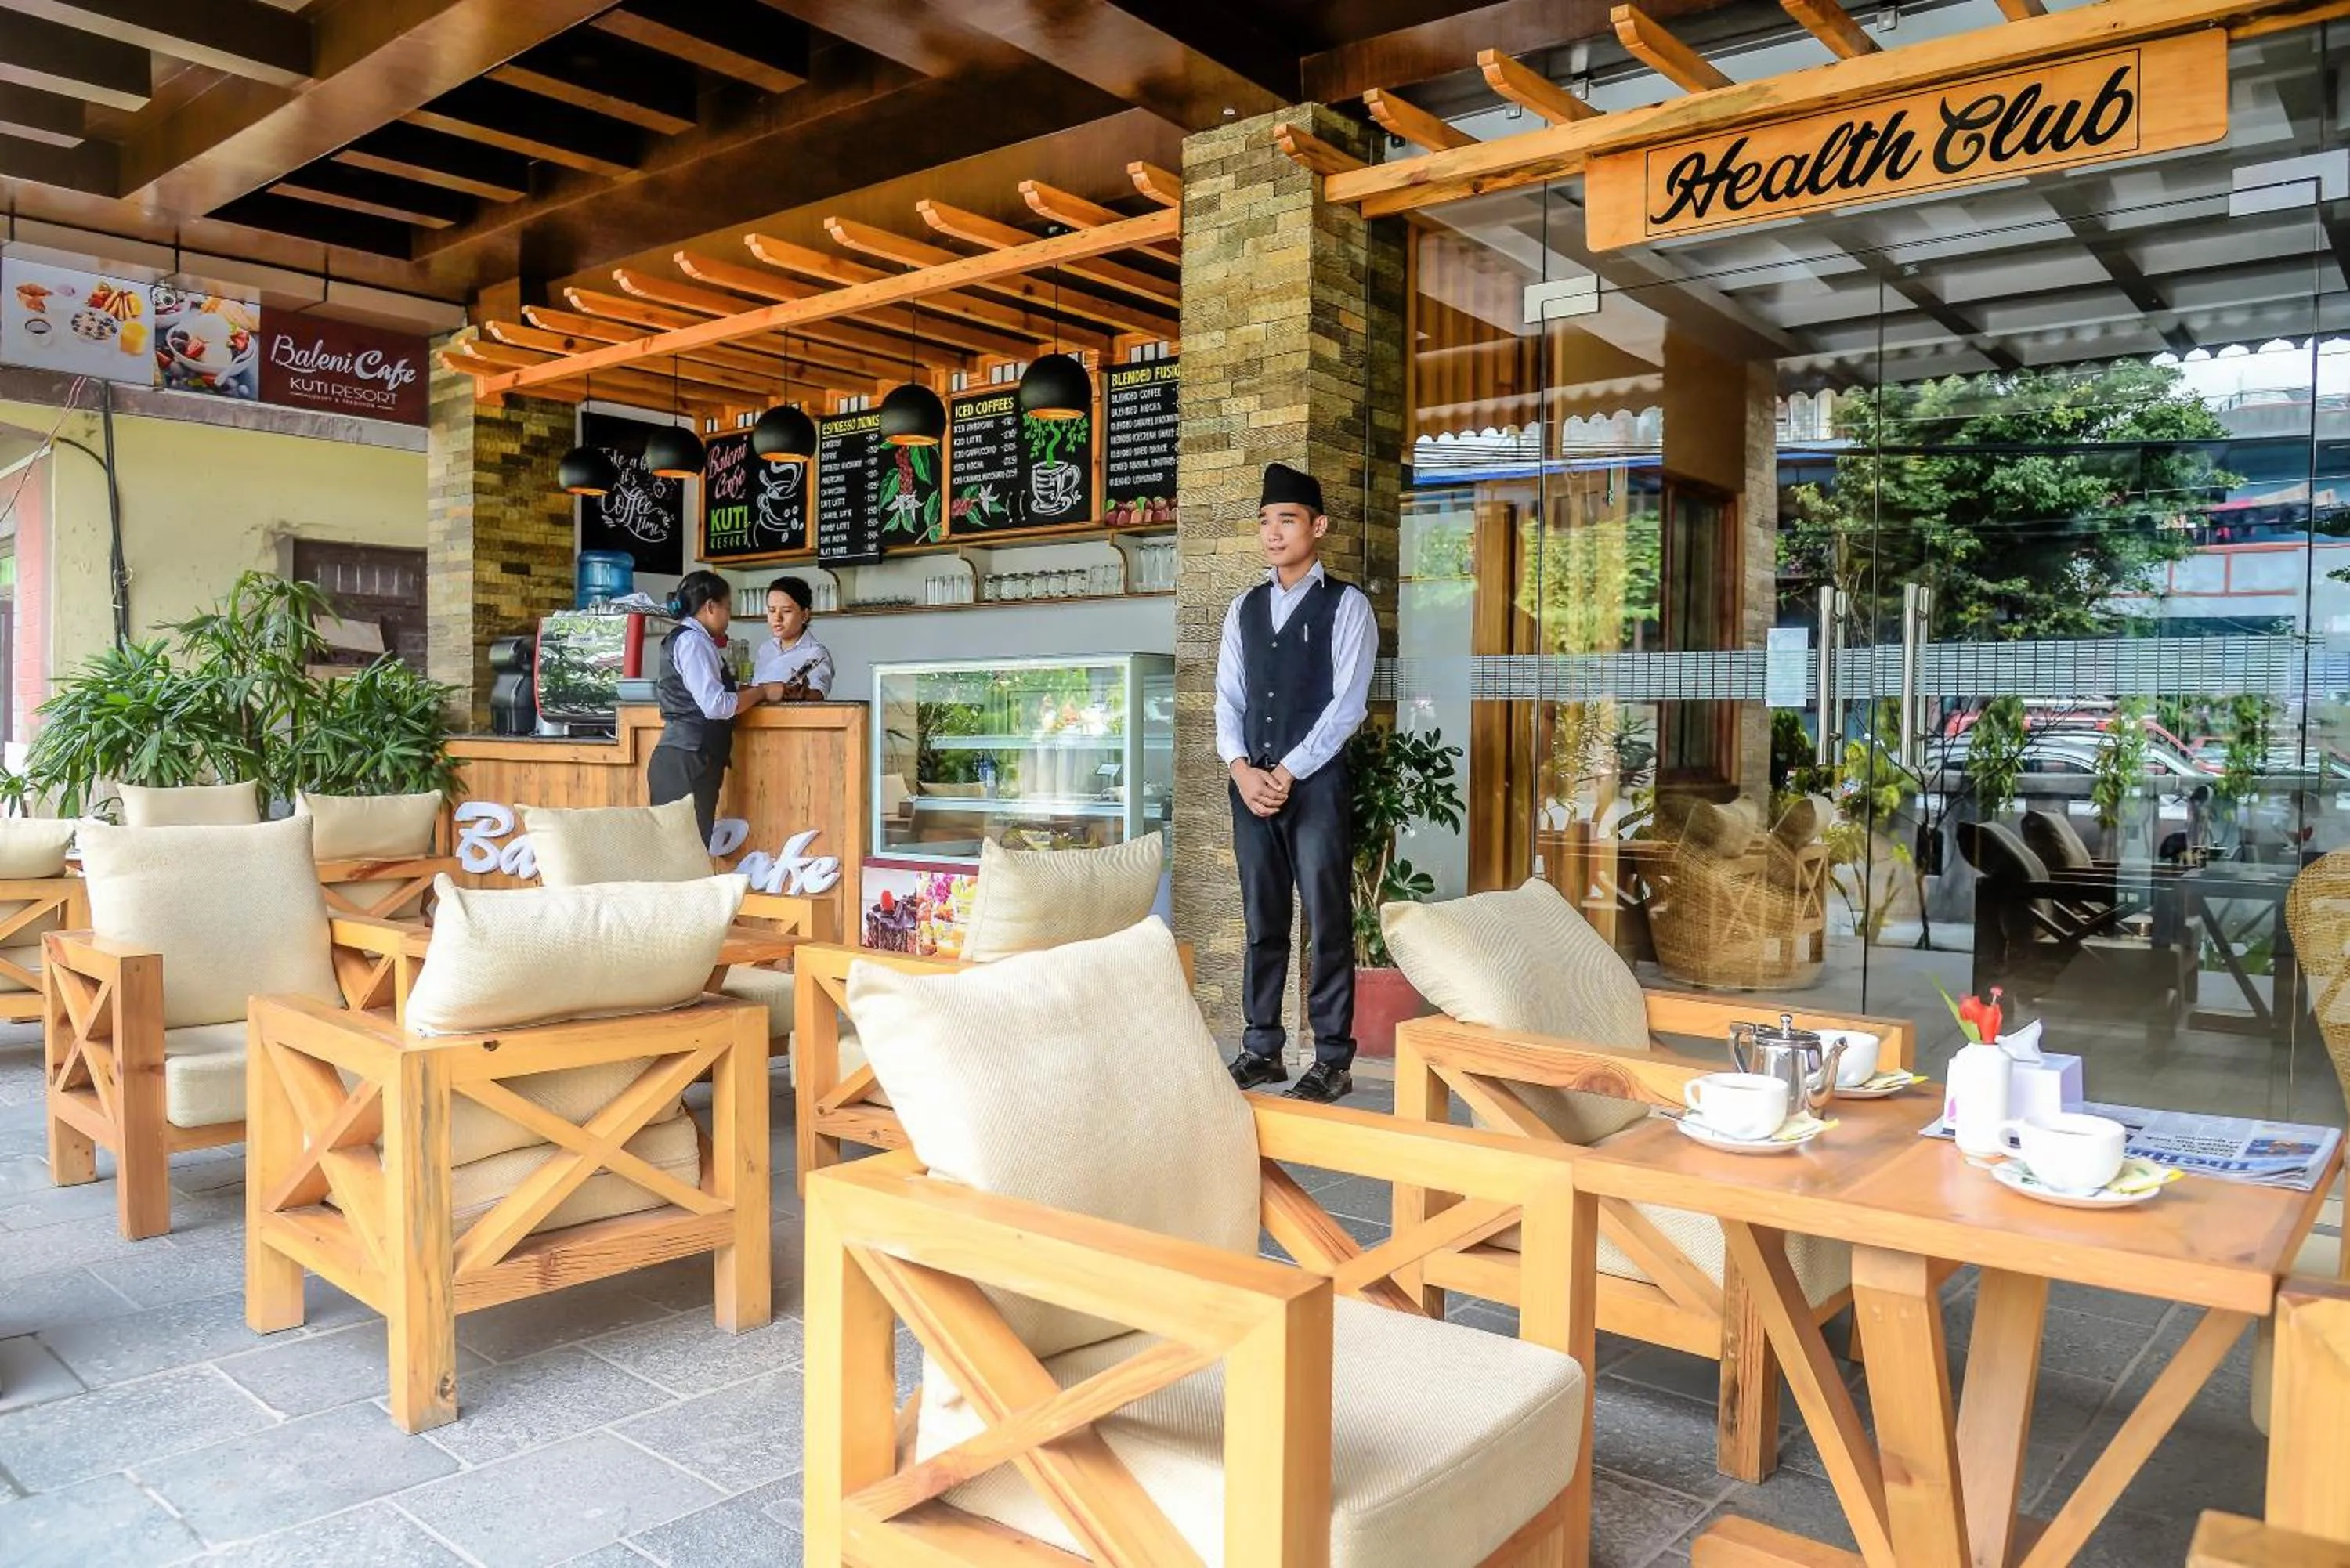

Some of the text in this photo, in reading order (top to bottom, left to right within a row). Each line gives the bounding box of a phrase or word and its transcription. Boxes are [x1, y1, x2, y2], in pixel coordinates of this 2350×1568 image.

[1649, 65, 2135, 226] Health Club
[270, 334, 417, 391] Baleni Cafe
[1112, 363, 1180, 387] BLENDED FUSIO
[290, 377, 329, 394] KUTI
[331, 383, 399, 405] RESORT
[955, 396, 1014, 418] ICED COFFEES
[822, 417, 856, 435] ESPRESSO
[710, 505, 750, 533] KUTI
